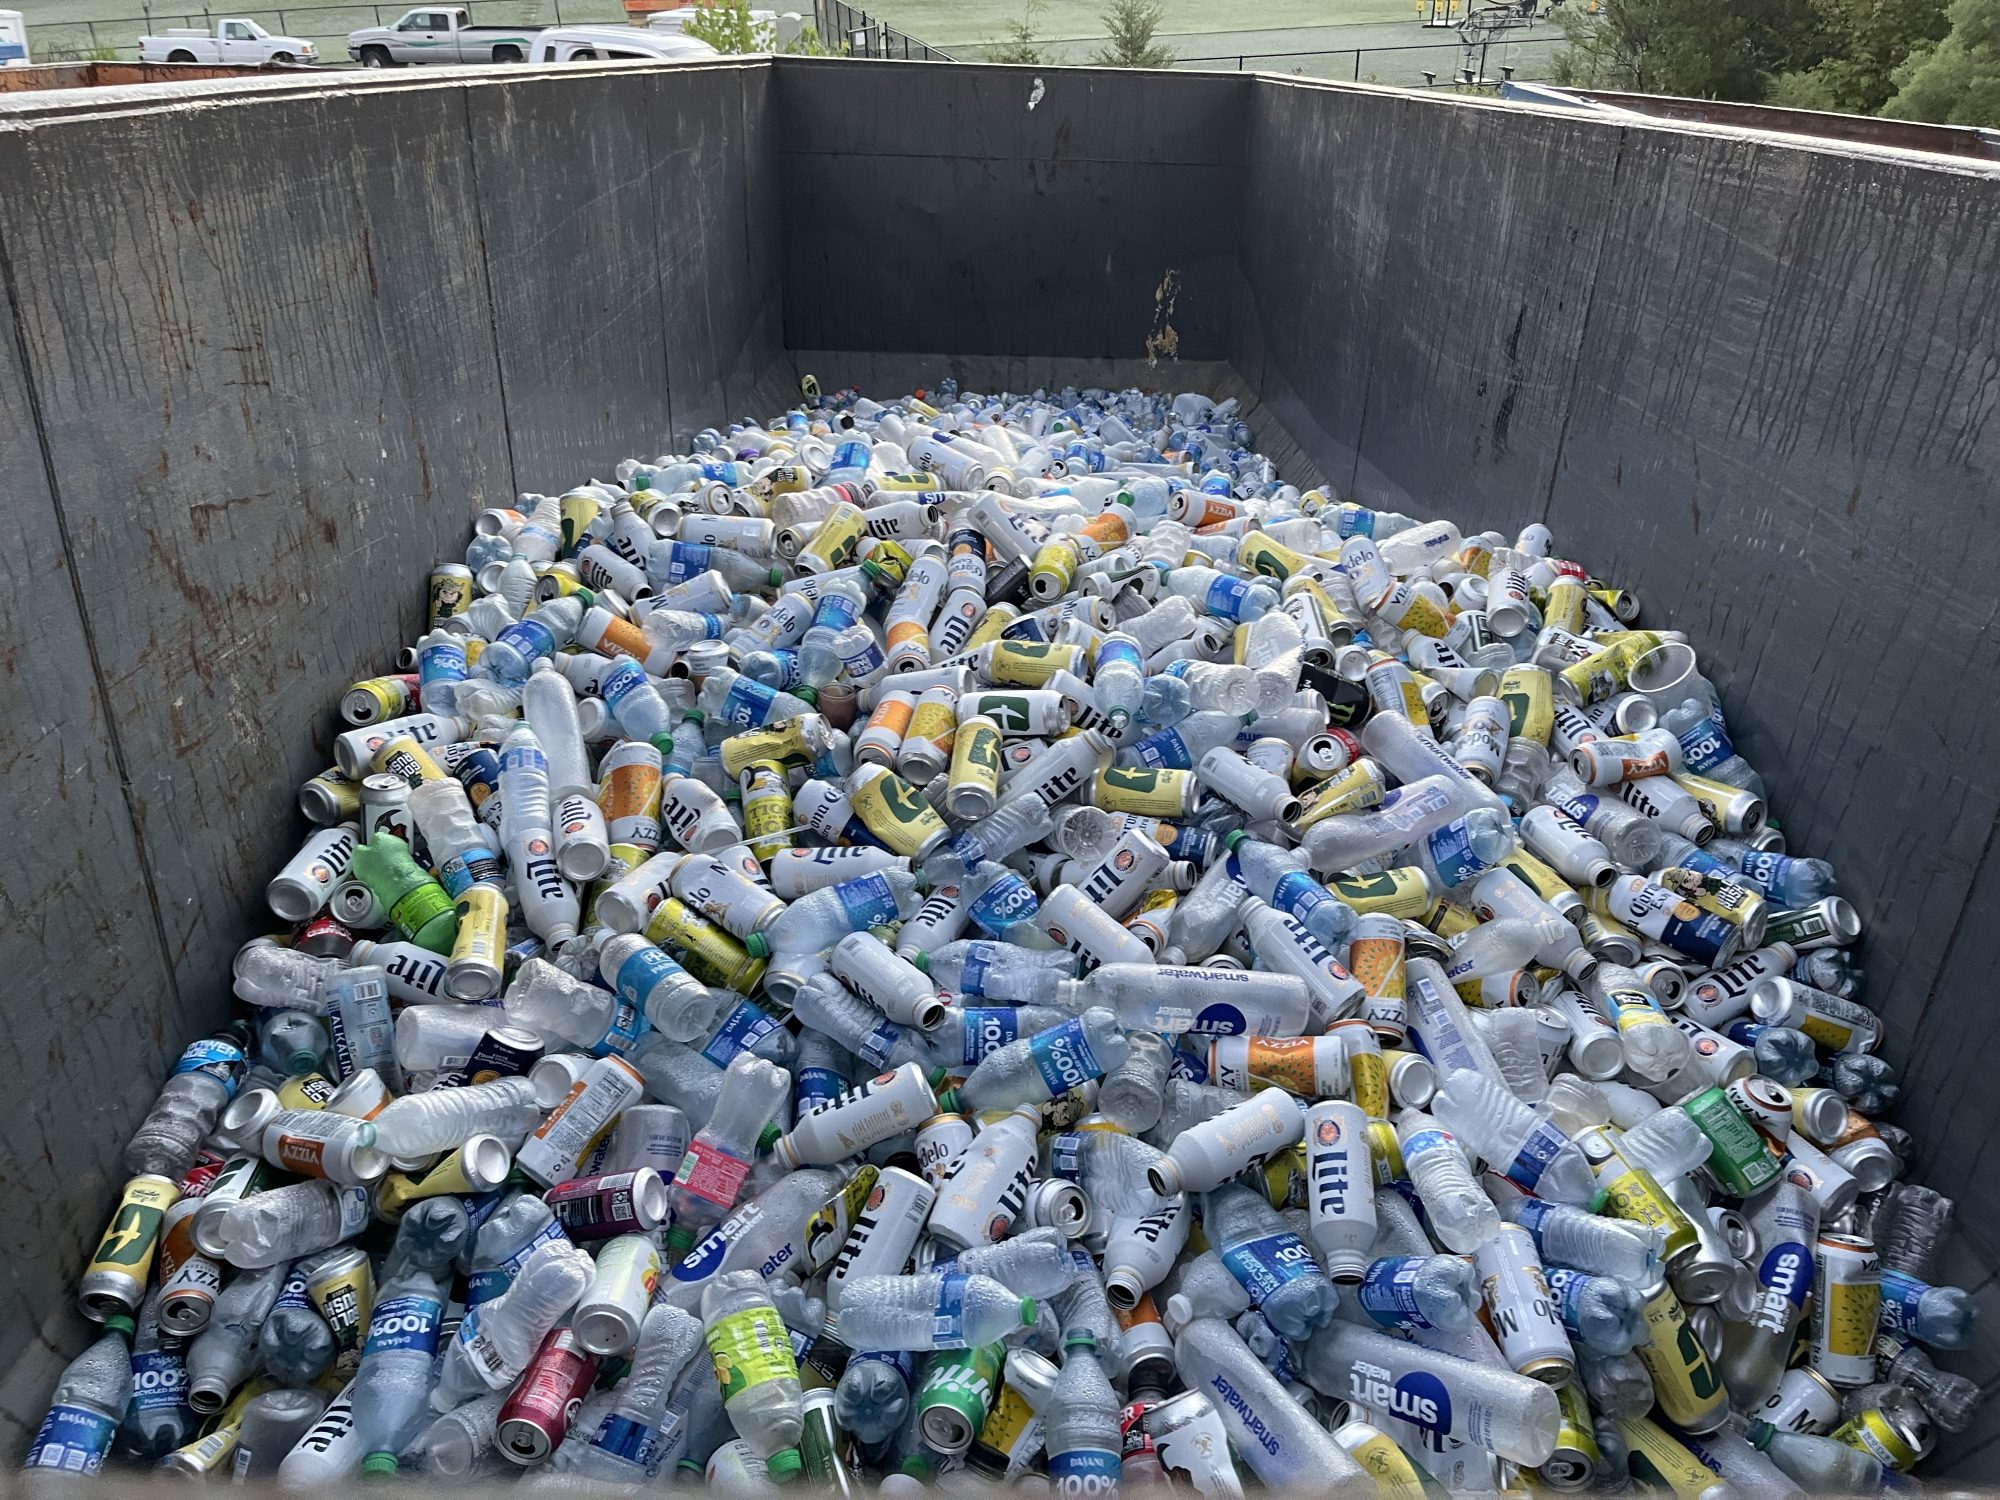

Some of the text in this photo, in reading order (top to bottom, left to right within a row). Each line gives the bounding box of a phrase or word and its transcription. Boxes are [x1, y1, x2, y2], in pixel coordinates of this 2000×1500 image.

[869, 517, 900, 539] Lite
[1034, 765, 1078, 807] Lite
[317, 835, 352, 879] Lite
[526, 858, 564, 901] Lite
[1284, 918, 1330, 967] Lite
[387, 953, 444, 998] Lite
[1157, 967, 1250, 983] smartwater
[1447, 959, 1474, 979] ater
[1715, 954, 1767, 999] Lite
[332, 1012, 355, 1080] ALKALIN
[983, 1016, 1000, 1055] 100
[1153, 1015, 1236, 1035] smart
[1256, 1037, 1311, 1049] VIZZY
[188, 1039, 236, 1059] POWER
[1048, 1038, 1083, 1088] 100%
[997, 1155, 1037, 1216] Lite
[1313, 1150, 1348, 1216] Lite
[682, 1201, 760, 1270] smart
[835, 1216, 879, 1281] Lite
[1274, 1244, 1312, 1263] 100
[1757, 1252, 1800, 1335] smart
[1211, 1373, 1281, 1458] smartwater
[1350, 1371, 1439, 1425] smart
